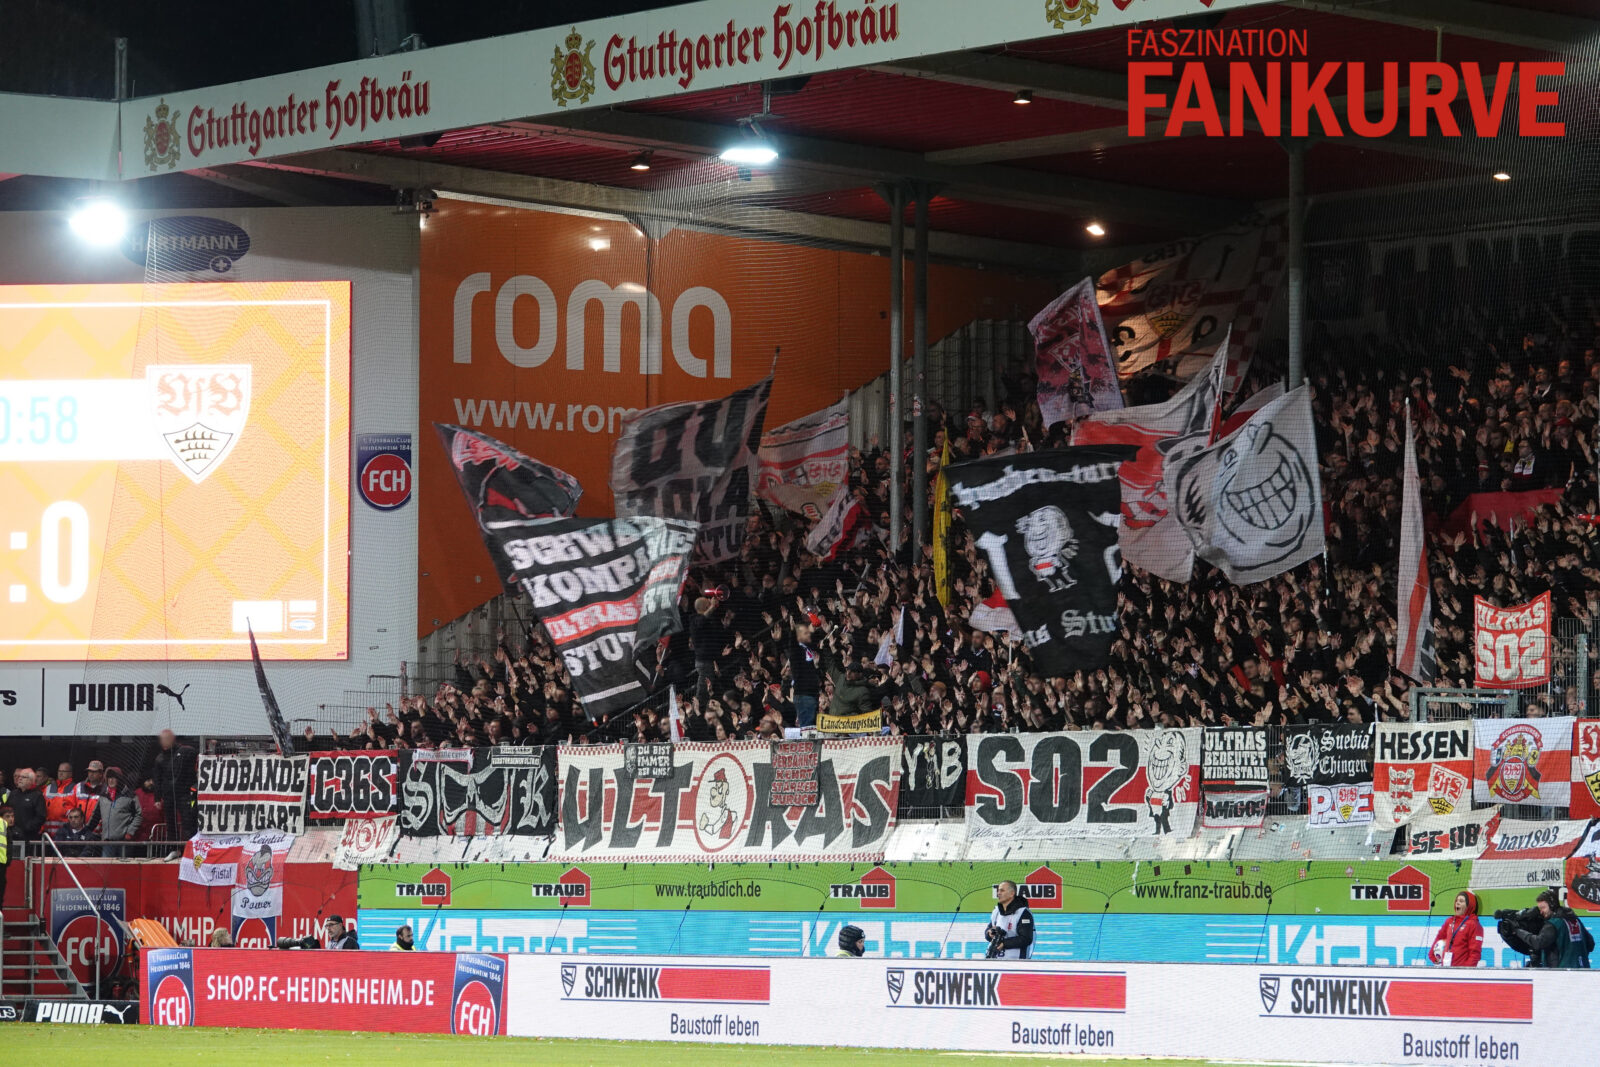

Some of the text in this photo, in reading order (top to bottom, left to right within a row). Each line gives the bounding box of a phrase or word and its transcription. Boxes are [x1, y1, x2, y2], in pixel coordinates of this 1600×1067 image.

[604, 1, 900, 91] Stuttgarter Hofbräu
[187, 70, 430, 157] Stuttgarter Hofbräu
[131, 235, 239, 251] HARTMANN
[453, 272, 732, 379] roma
[157, 372, 243, 417] VfB
[454, 398, 640, 434] www.rom
[369, 469, 406, 492] FCH
[1477, 601, 1546, 630] ULTRAS
[69, 684, 154, 711] PUMA
[637, 745, 671, 755] DU BIST
[1204, 731, 1266, 751] ULTRAS
[1380, 730, 1469, 760] HESSEN
[637, 756, 670, 767] IMMER
[1204, 751, 1267, 766] BEDEUTET
[199, 757, 305, 793] SÜDBANDE
[1203, 766, 1268, 780] WIDERSTAND
[198, 803, 301, 834] STUTTGART
[397, 884, 446, 896] TRAUB
[533, 884, 585, 896] TRAUB
[655, 881, 761, 898] www.traubdich.de
[831, 884, 889, 898] TRAUB
[993, 884, 1055, 898] TAUB
[1135, 881, 1273, 900] www.franz-traub.de
[1352, 885, 1422, 899] TRAUB
[56, 904, 100, 912] HEIDENHEM
[66, 936, 110, 966] FCH
[207, 974, 434, 1006] SHOP.FC-HEIDENHEIM.DE
[585, 966, 659, 999] SCHWENK
[914, 971, 999, 1006] SCHWENK
[1291, 978, 1387, 1016] SCHWENK
[36, 1002, 104, 1024] PUMA
[159, 995, 186, 1026] FCH
[460, 1001, 491, 1036] FCH
[670, 1013, 760, 1036] Baustoff leben
[1012, 1022, 1114, 1047] Baustoff leben
[1403, 1033, 1519, 1060] Baustoff leben
